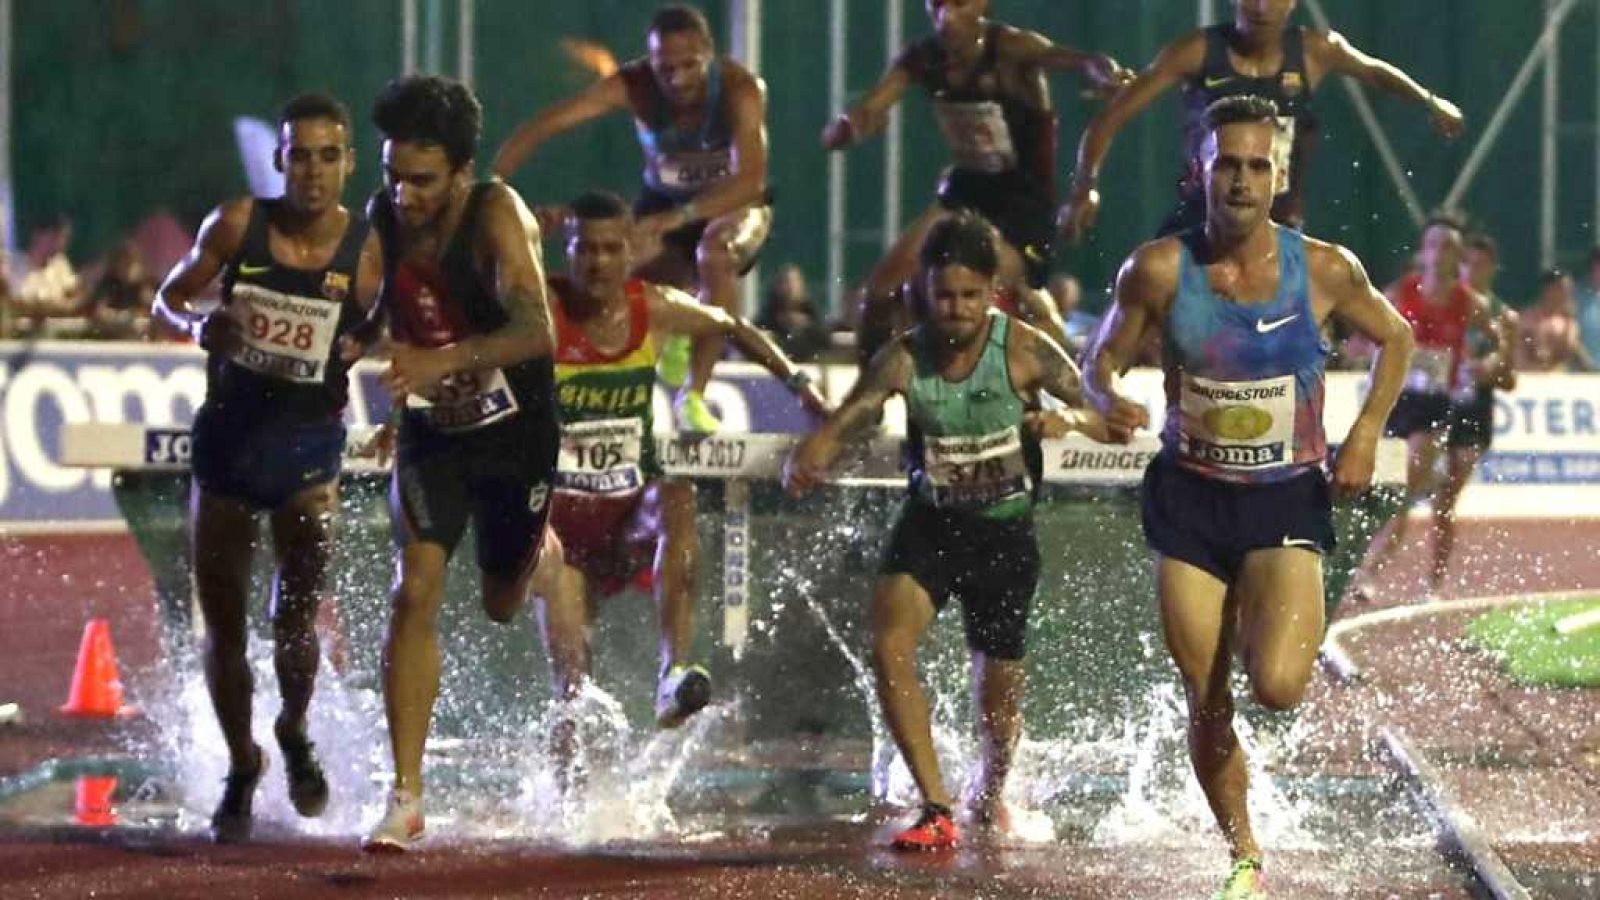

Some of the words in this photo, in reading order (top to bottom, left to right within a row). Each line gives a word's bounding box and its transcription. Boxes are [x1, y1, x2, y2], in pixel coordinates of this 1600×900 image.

[250, 313, 313, 350] 928
[559, 384, 647, 411] BIKILA
[576, 442, 624, 470] 105
[706, 440, 745, 468] 2017
